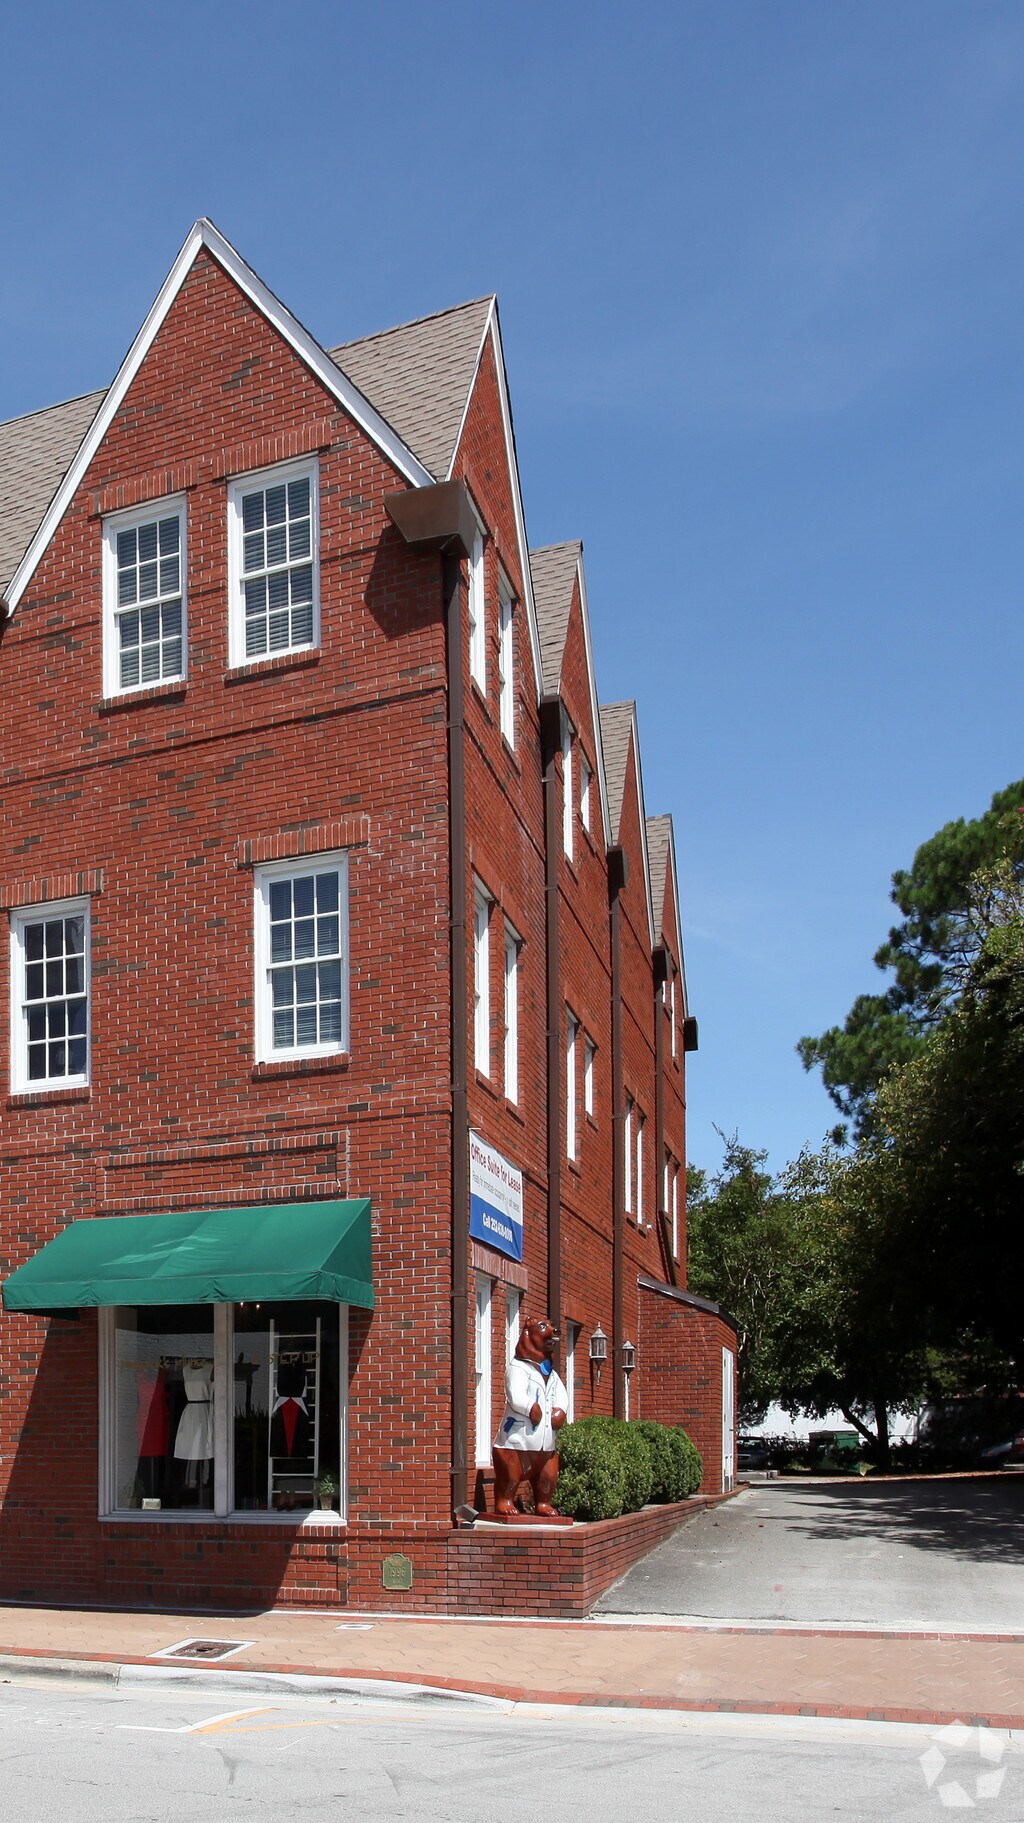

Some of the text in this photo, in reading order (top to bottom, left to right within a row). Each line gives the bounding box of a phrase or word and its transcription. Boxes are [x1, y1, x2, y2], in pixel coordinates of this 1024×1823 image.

[471, 1142, 486, 1168] Office
[488, 1155, 500, 1178] Suite
[507, 1171, 521, 1194] Lease
